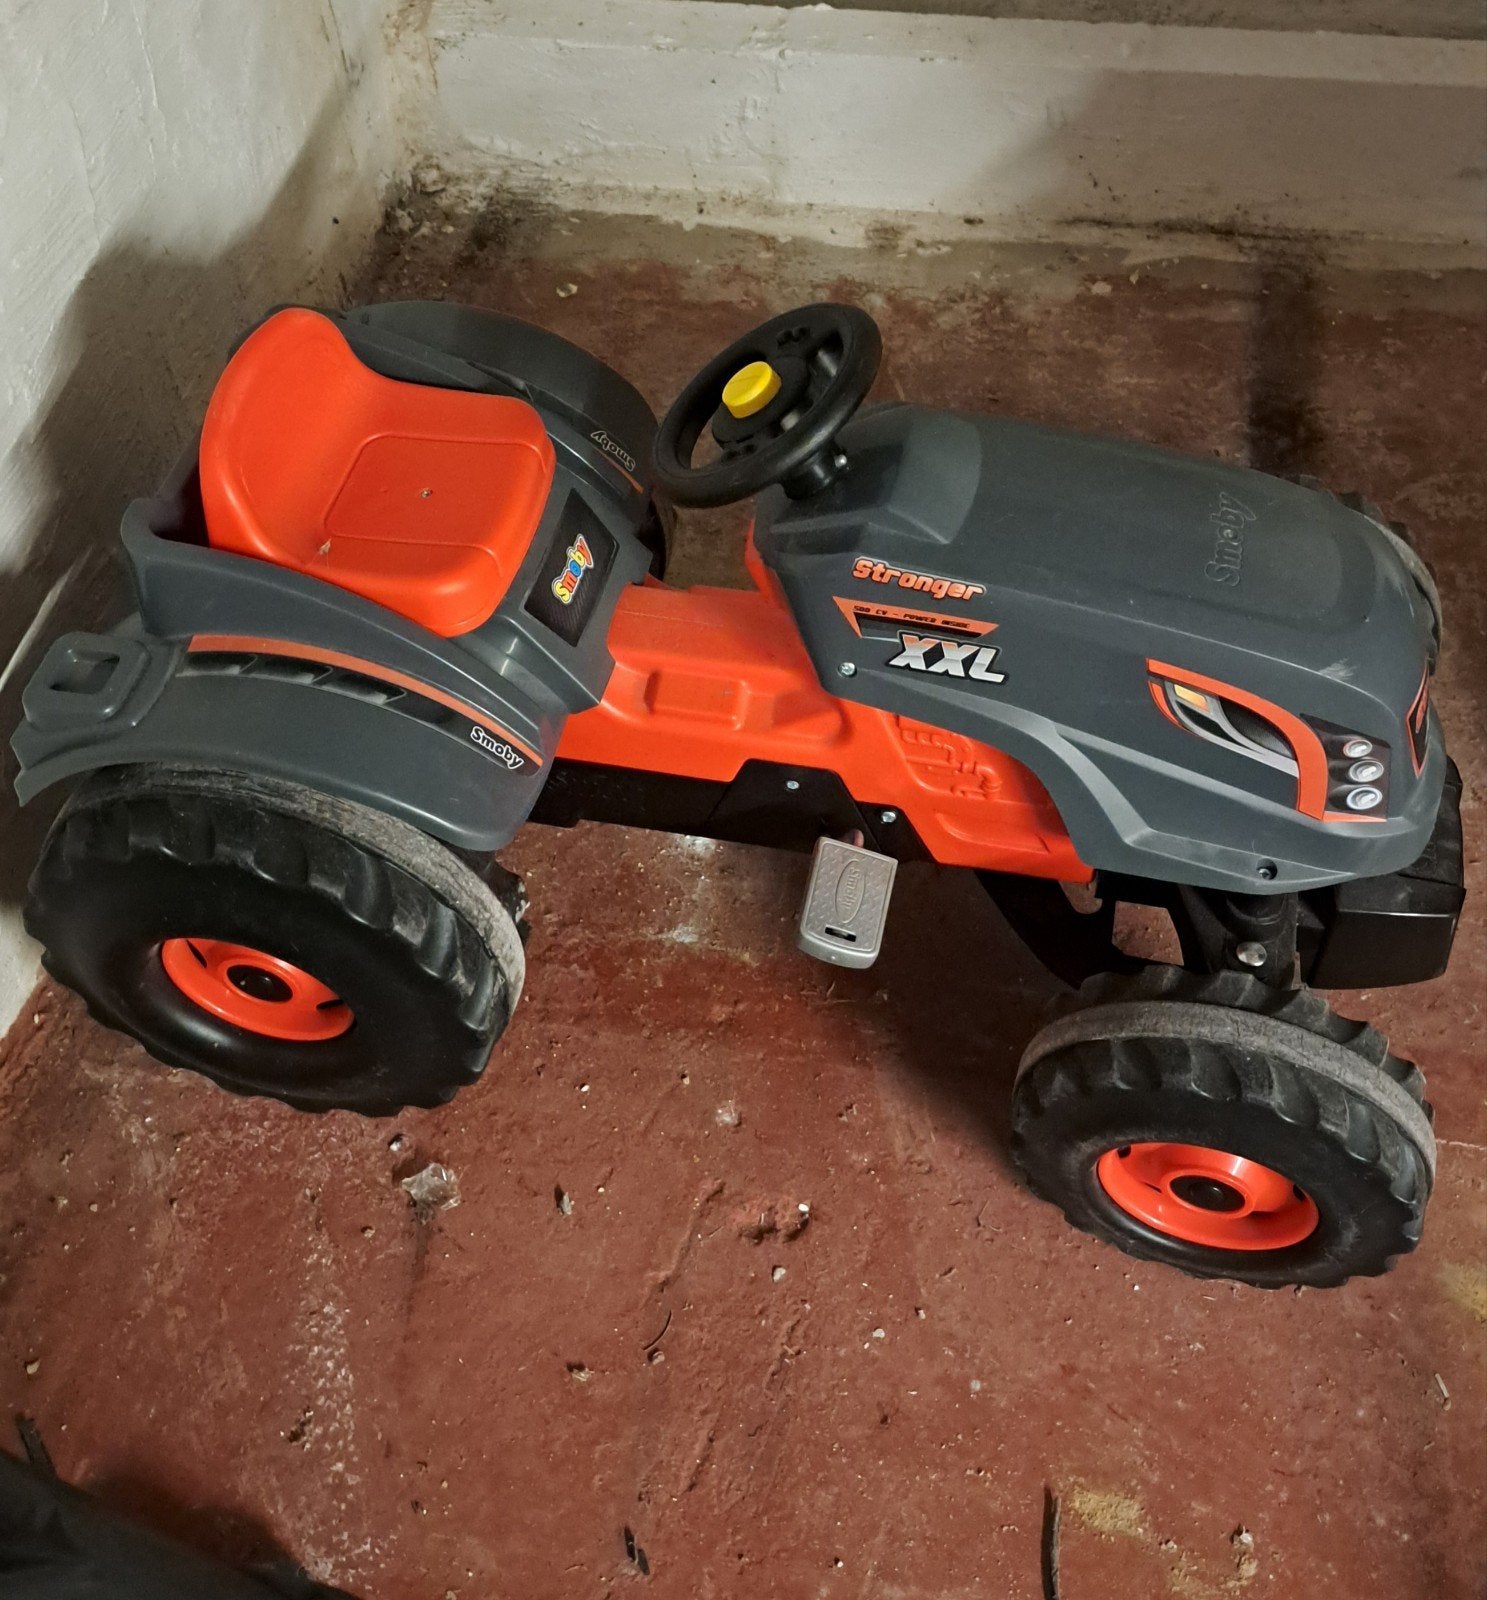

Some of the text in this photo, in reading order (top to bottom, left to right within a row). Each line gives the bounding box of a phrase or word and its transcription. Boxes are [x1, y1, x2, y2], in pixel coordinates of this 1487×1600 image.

[590, 430, 636, 472] Smoby
[1204, 491, 1256, 586] Smoby
[552, 533, 593, 604] Smoby
[852, 557, 985, 600] Stronger
[903, 613, 937, 623] POWER
[888, 632, 1007, 684] XXL
[470, 726, 525, 770] Smoby
